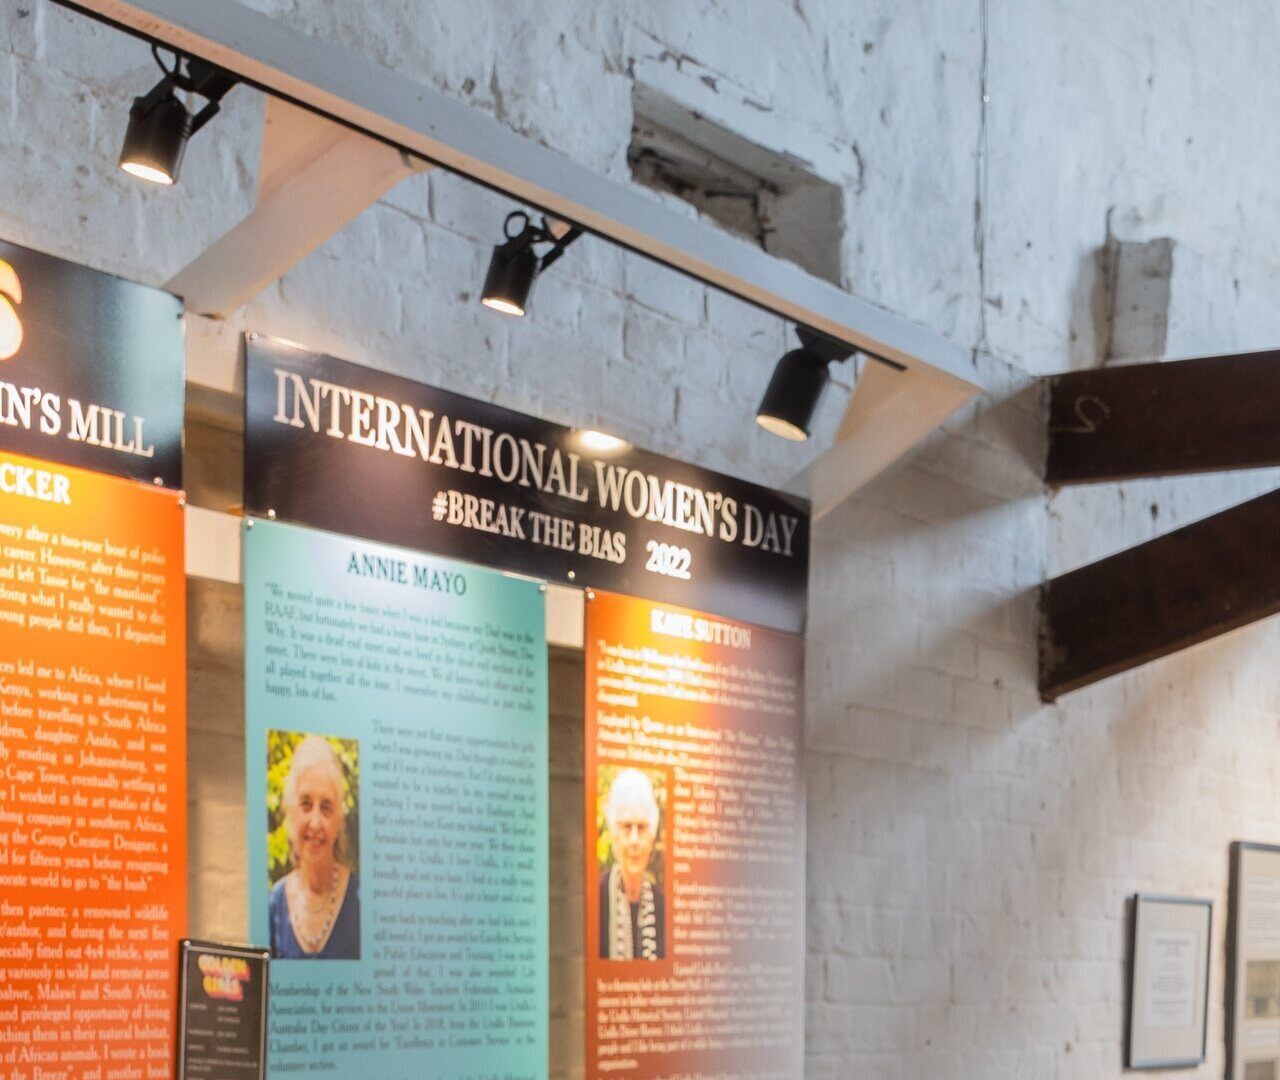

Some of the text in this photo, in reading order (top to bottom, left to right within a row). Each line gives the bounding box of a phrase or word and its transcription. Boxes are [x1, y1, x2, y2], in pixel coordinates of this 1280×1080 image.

[66, 399, 155, 458] MILL
[273, 368, 799, 556] INTERNATIONAL WOMEN’S DAY
[432, 490, 692, 580] #BREAK THE BIAS 2022
[347, 552, 468, 596] ANNIE MAYO
[694, 616, 752, 649] SUTTON
